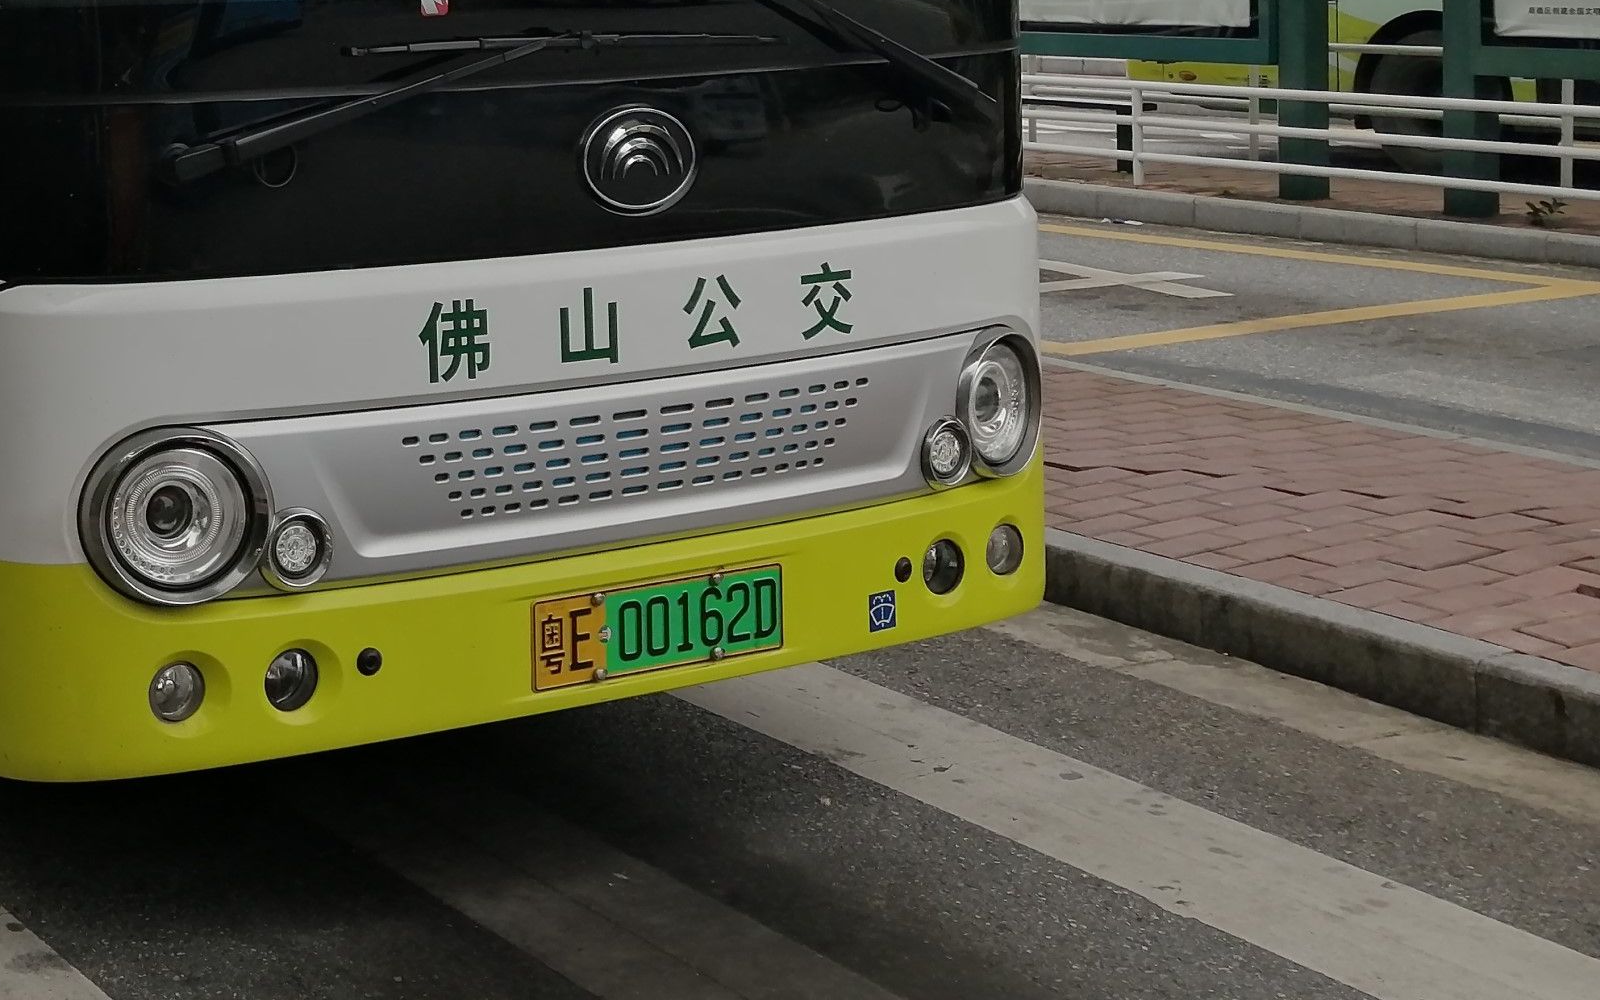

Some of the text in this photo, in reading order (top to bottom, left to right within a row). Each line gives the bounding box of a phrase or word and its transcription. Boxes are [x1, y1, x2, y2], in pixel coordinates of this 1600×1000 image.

[418, 261, 855, 385] 佛山公交
[617, 576, 779, 662] 00162D
